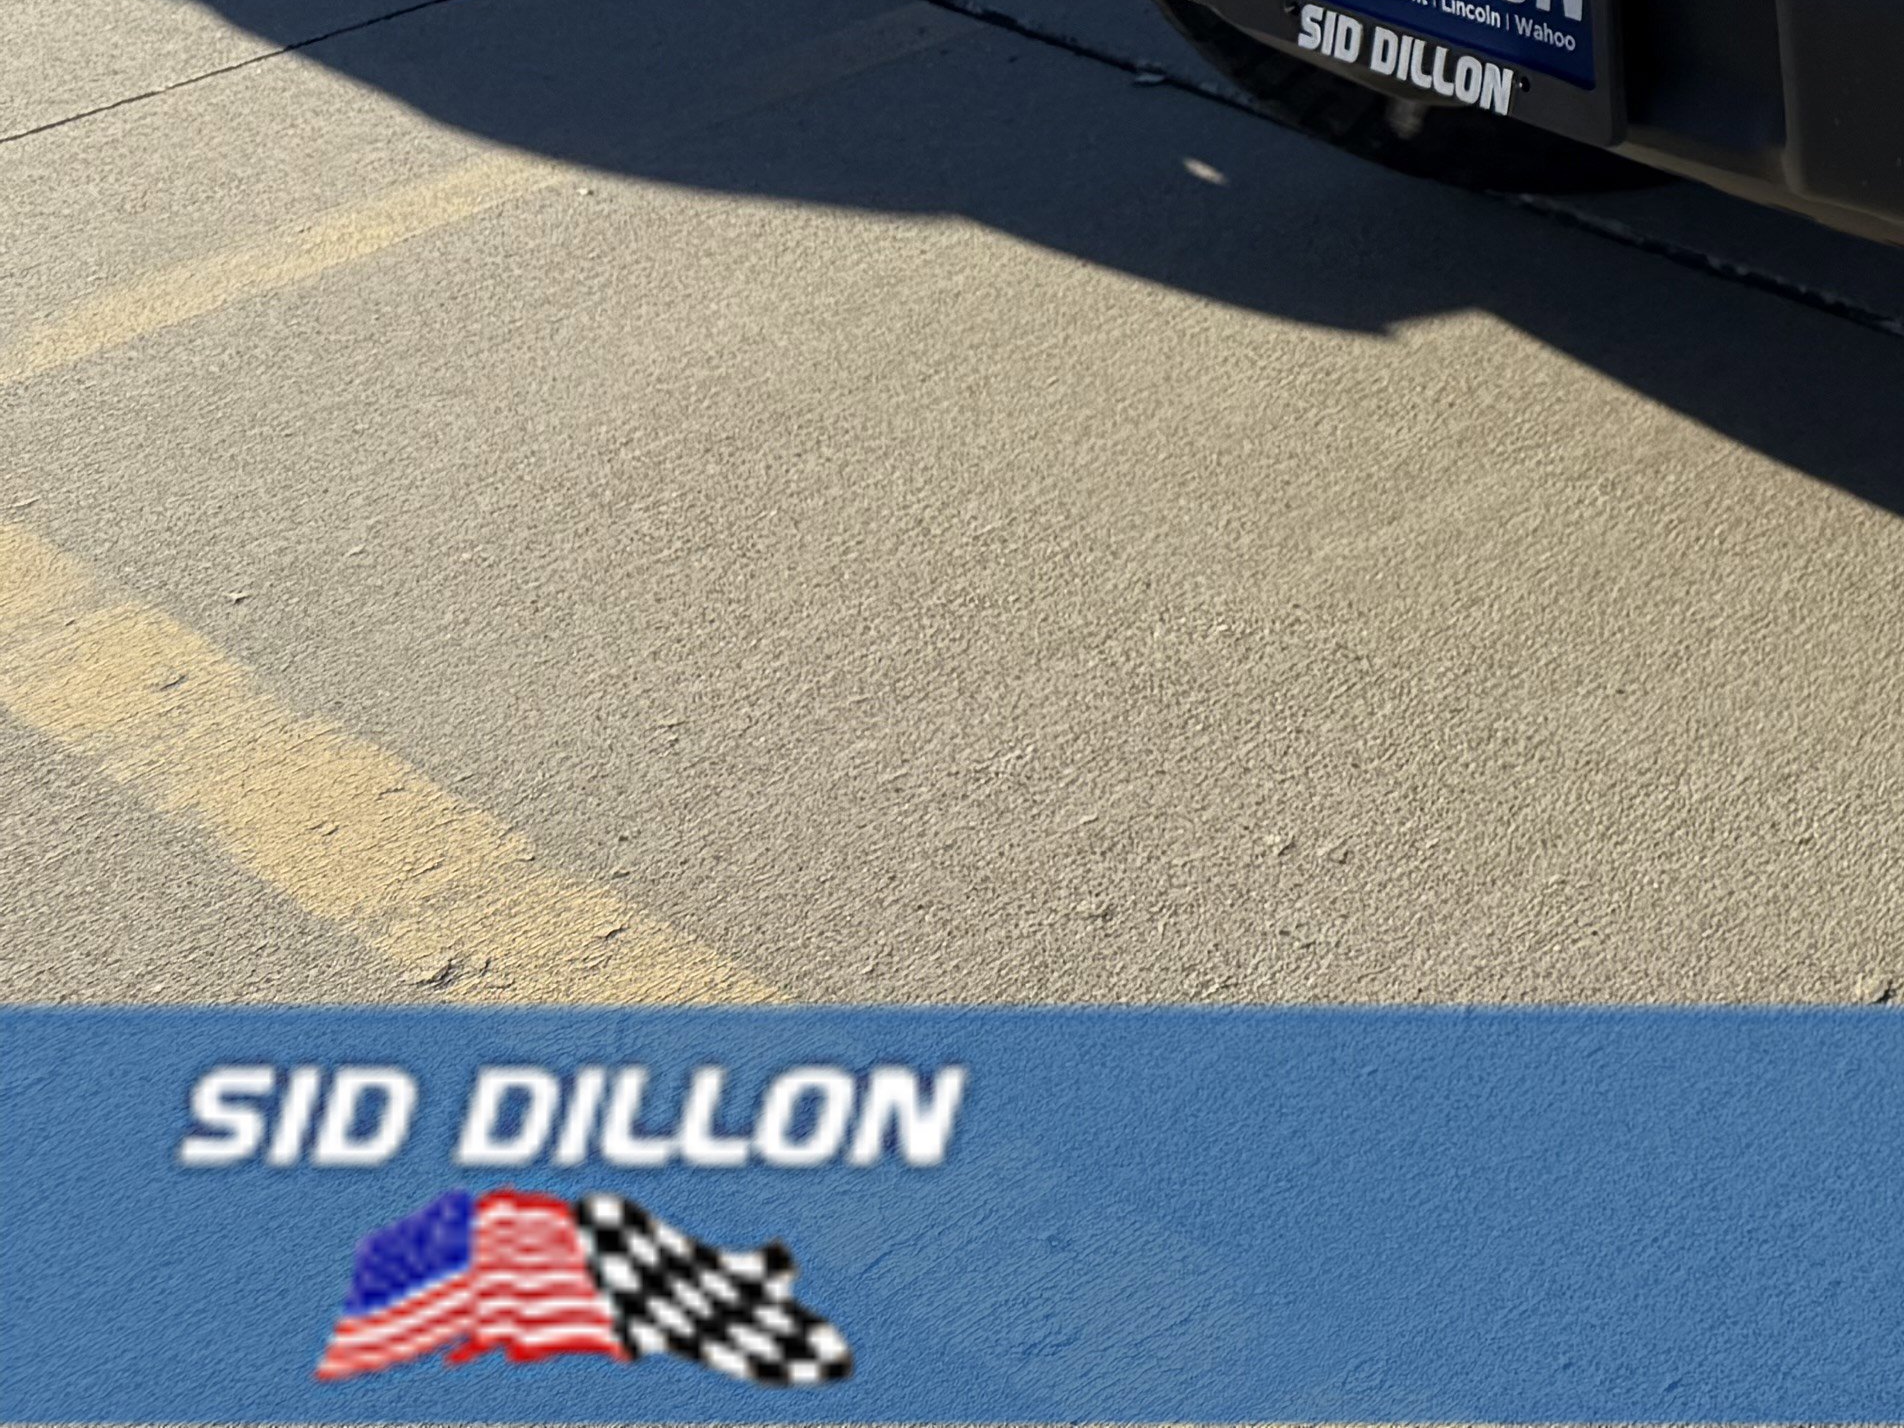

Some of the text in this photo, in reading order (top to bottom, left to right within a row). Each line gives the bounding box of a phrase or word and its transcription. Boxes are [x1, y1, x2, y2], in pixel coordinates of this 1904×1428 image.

[1297, 4, 1515, 117] SID DILLON
[1514, 13, 1577, 52] Wahoo
